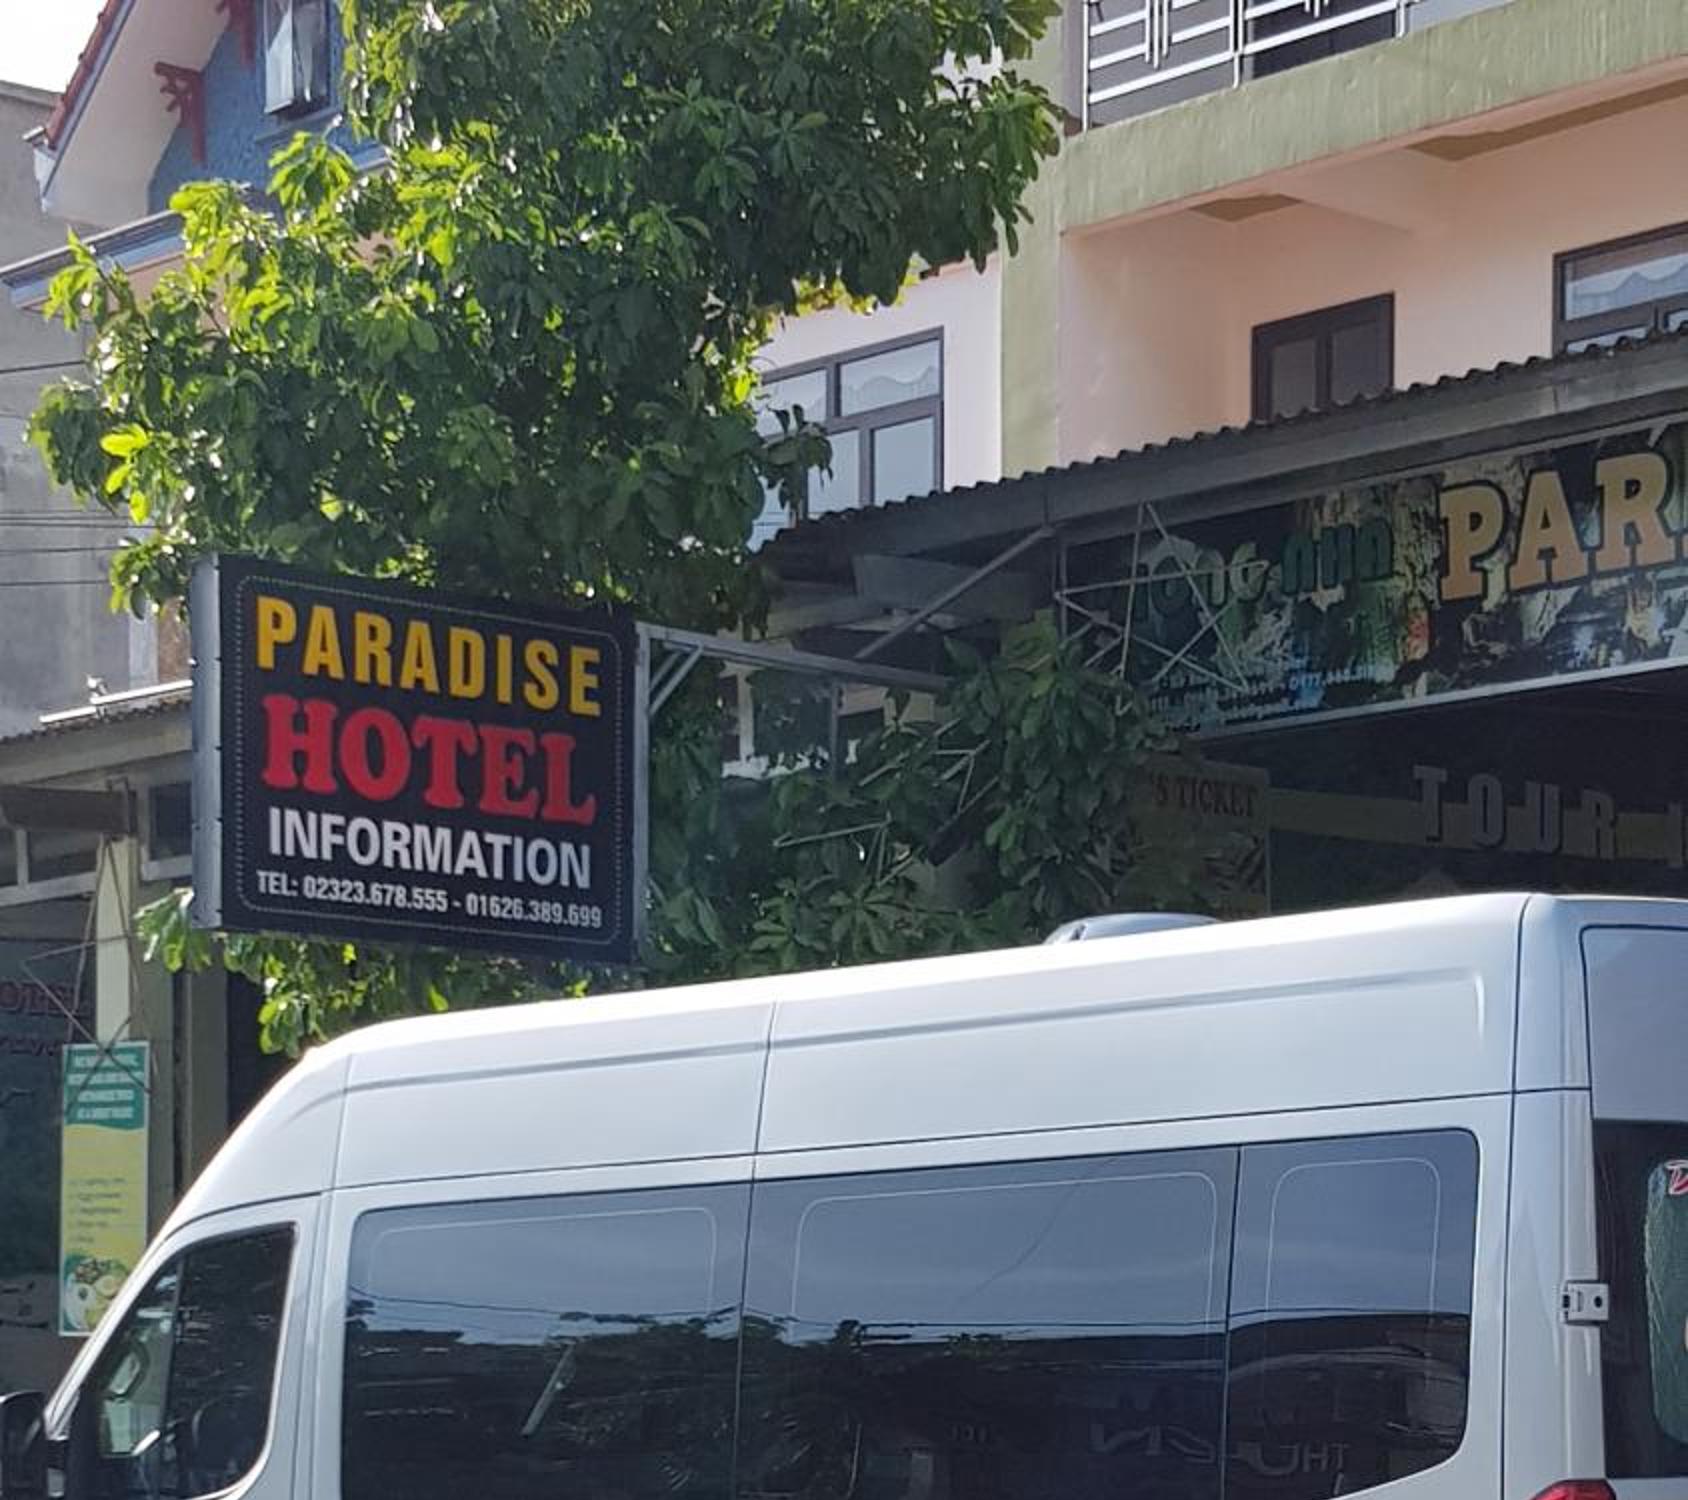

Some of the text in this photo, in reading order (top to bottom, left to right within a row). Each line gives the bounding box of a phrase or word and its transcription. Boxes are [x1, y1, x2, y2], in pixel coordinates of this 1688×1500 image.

[1440, 451, 1688, 601] PAR
[257, 597, 602, 717] PARADISE
[262, 694, 596, 824] HOTEL
[1412, 763, 1617, 862] TOUR
[256, 869, 299, 898] TEL:
[304, 875, 447, 913] 02323.678.555
[466, 893, 602, 928] 01626.389.699
[268, 806, 592, 889] INFORMATION
